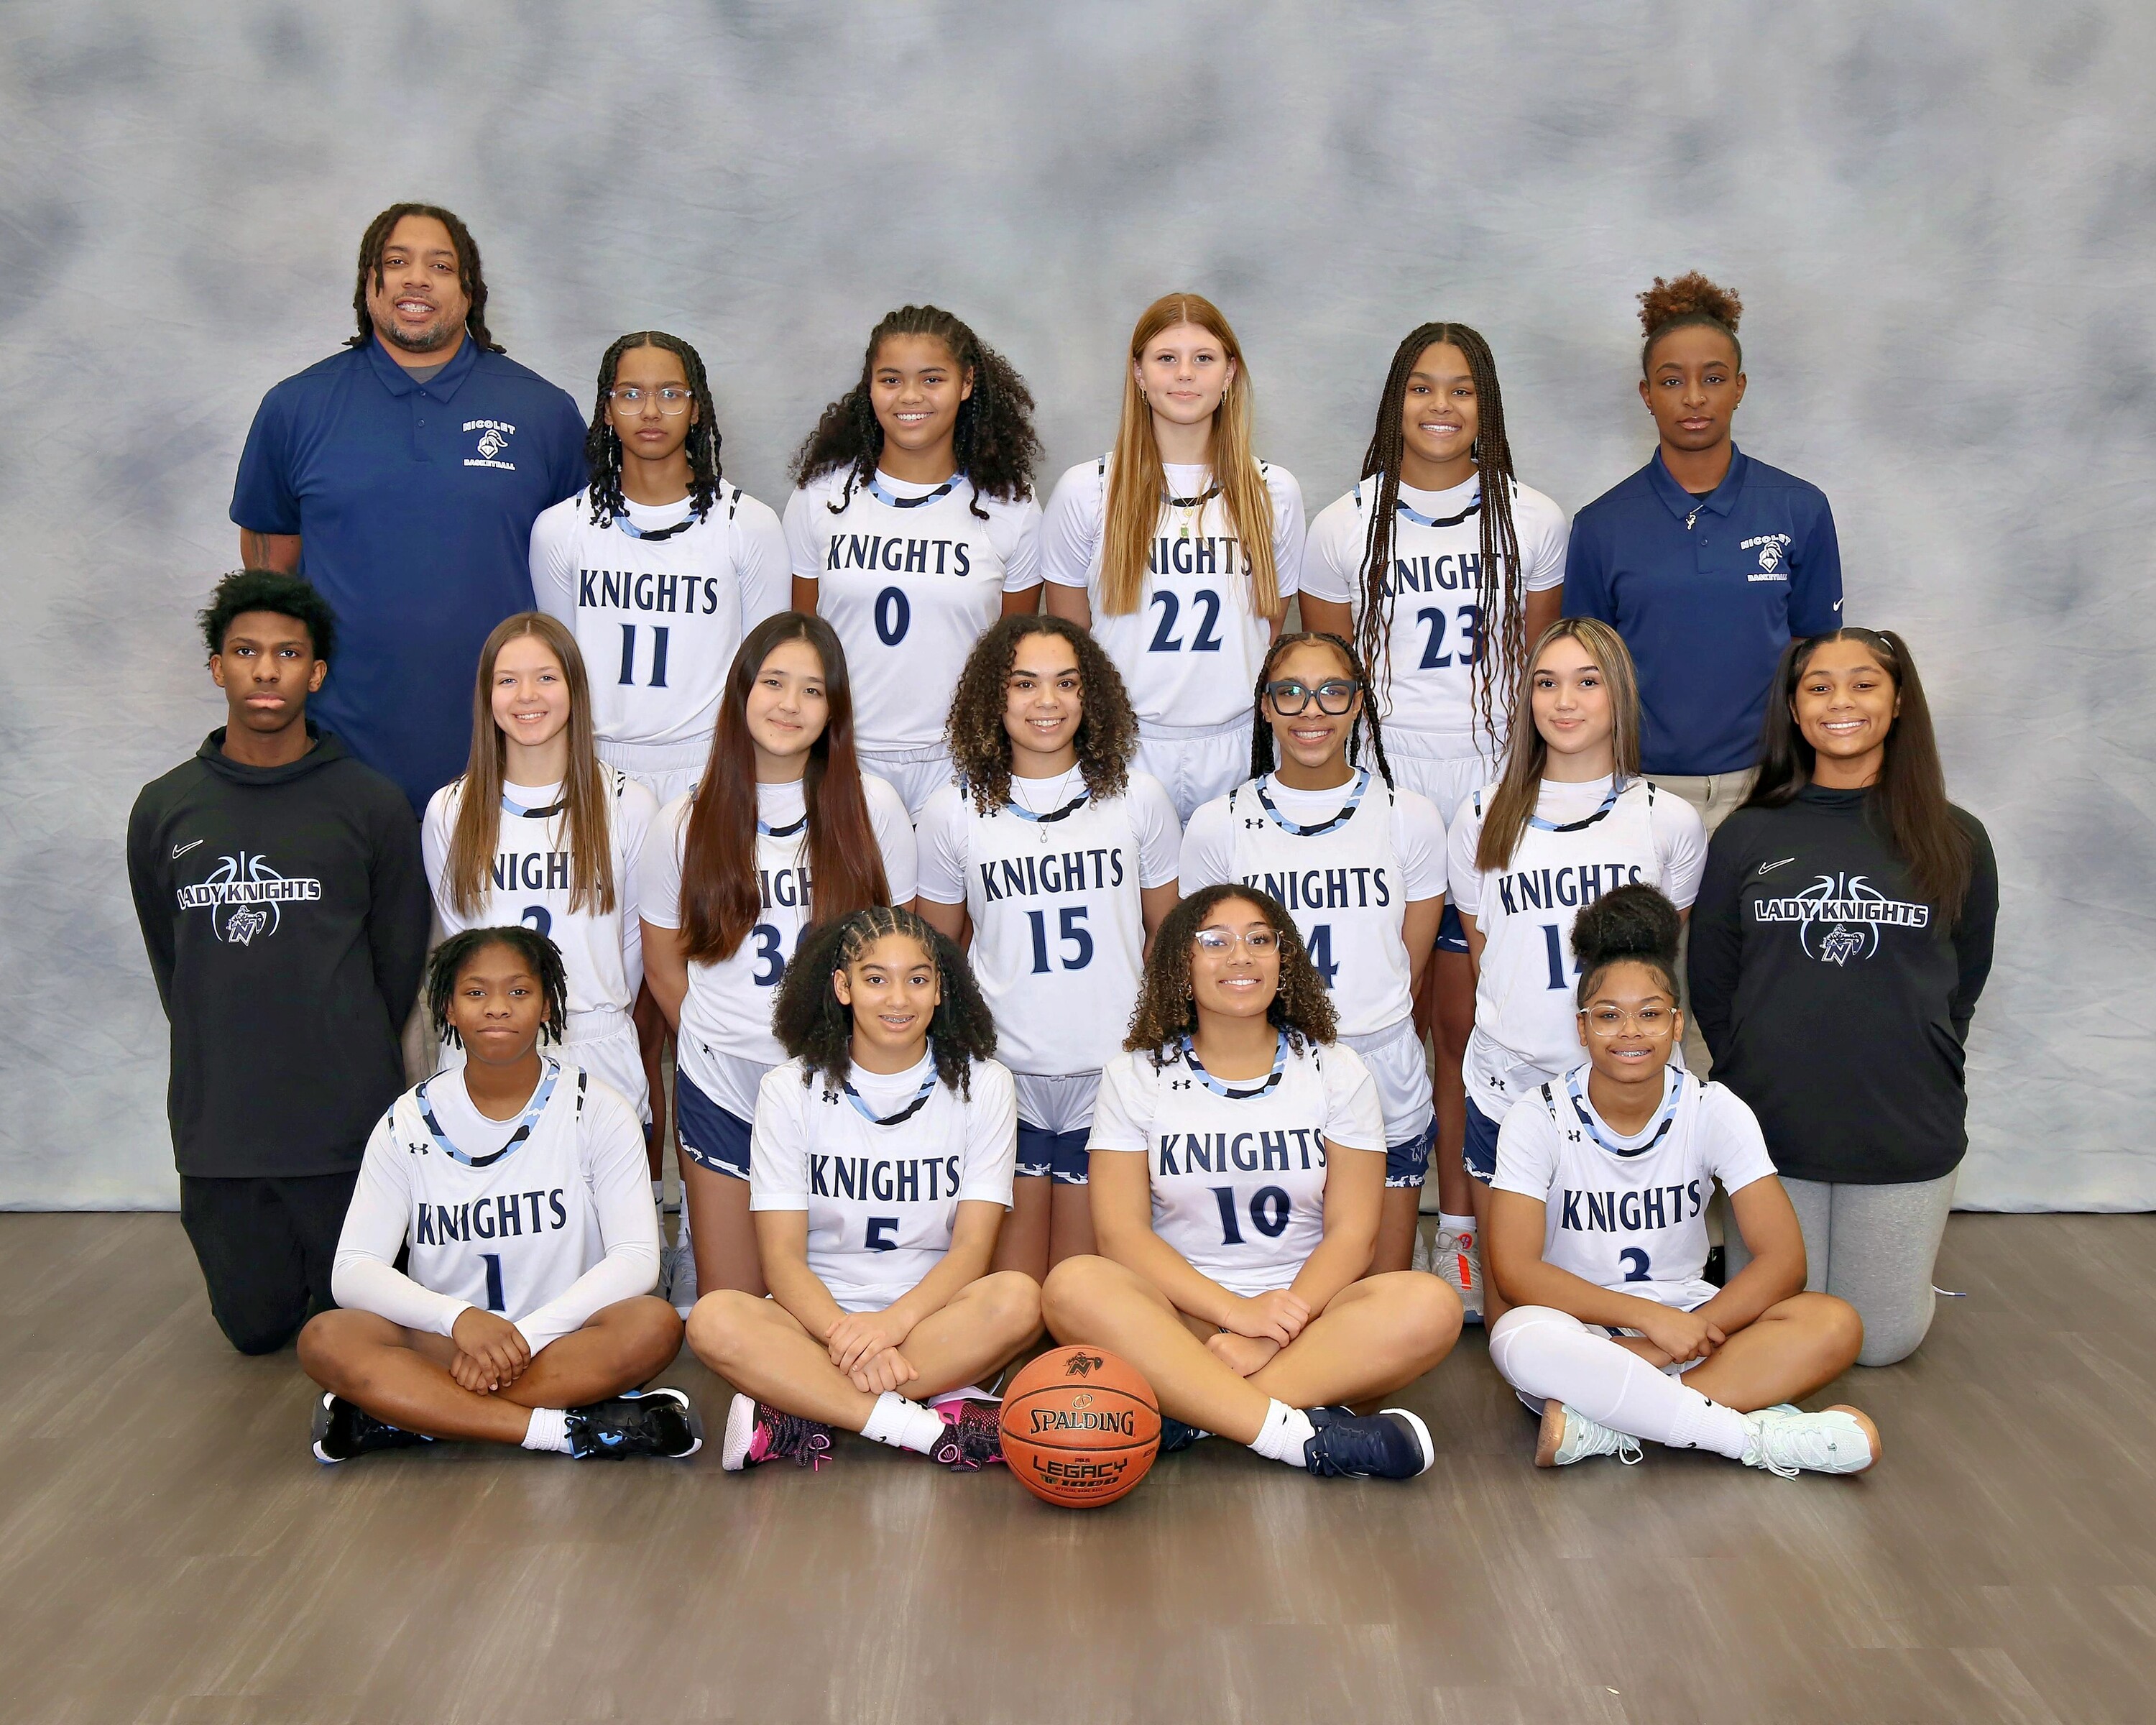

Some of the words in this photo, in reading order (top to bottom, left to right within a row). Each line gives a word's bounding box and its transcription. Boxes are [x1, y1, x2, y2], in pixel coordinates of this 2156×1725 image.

[462, 419, 516, 435] NICOLET
[464, 459, 516, 471] BASKETBALL
[826, 534, 970, 577] KNIGHTS
[1740, 533, 1792, 550] NICOLET
[578, 569, 718, 615] KNIGHTS
[1378, 553, 1516, 600] KNIGHT
[1747, 574, 1787, 582] BASKETBALL
[874, 586, 911, 648] 0
[1147, 588, 1224, 653] 22
[1415, 604, 1485, 671] 23
[616, 622, 669, 689] 11
[225, 878, 322, 906] KNIGHTS
[980, 848, 1124, 903] KNIGHTS
[1754, 898, 1817, 922] LADY
[1820, 899, 1929, 929] KNIGHTS
[1021, 905, 1095, 975] 15
[1158, 1128, 1327, 1176] KNIGHTS
[811, 1154, 960, 1202] KNIGHTS
[416, 1188, 566, 1246] KNIGHTS
[1207, 1185, 1293, 1246] 10
[1561, 1179, 1701, 1233] KNIGHTS
[863, 1216, 900, 1253] 5
[476, 1252, 506, 1312] 1
[1030, 1409, 1135, 1438] SPALDING
[1033, 1455, 1128, 1479] LEGACY
[1061, 1476, 1120, 1489] 1000
